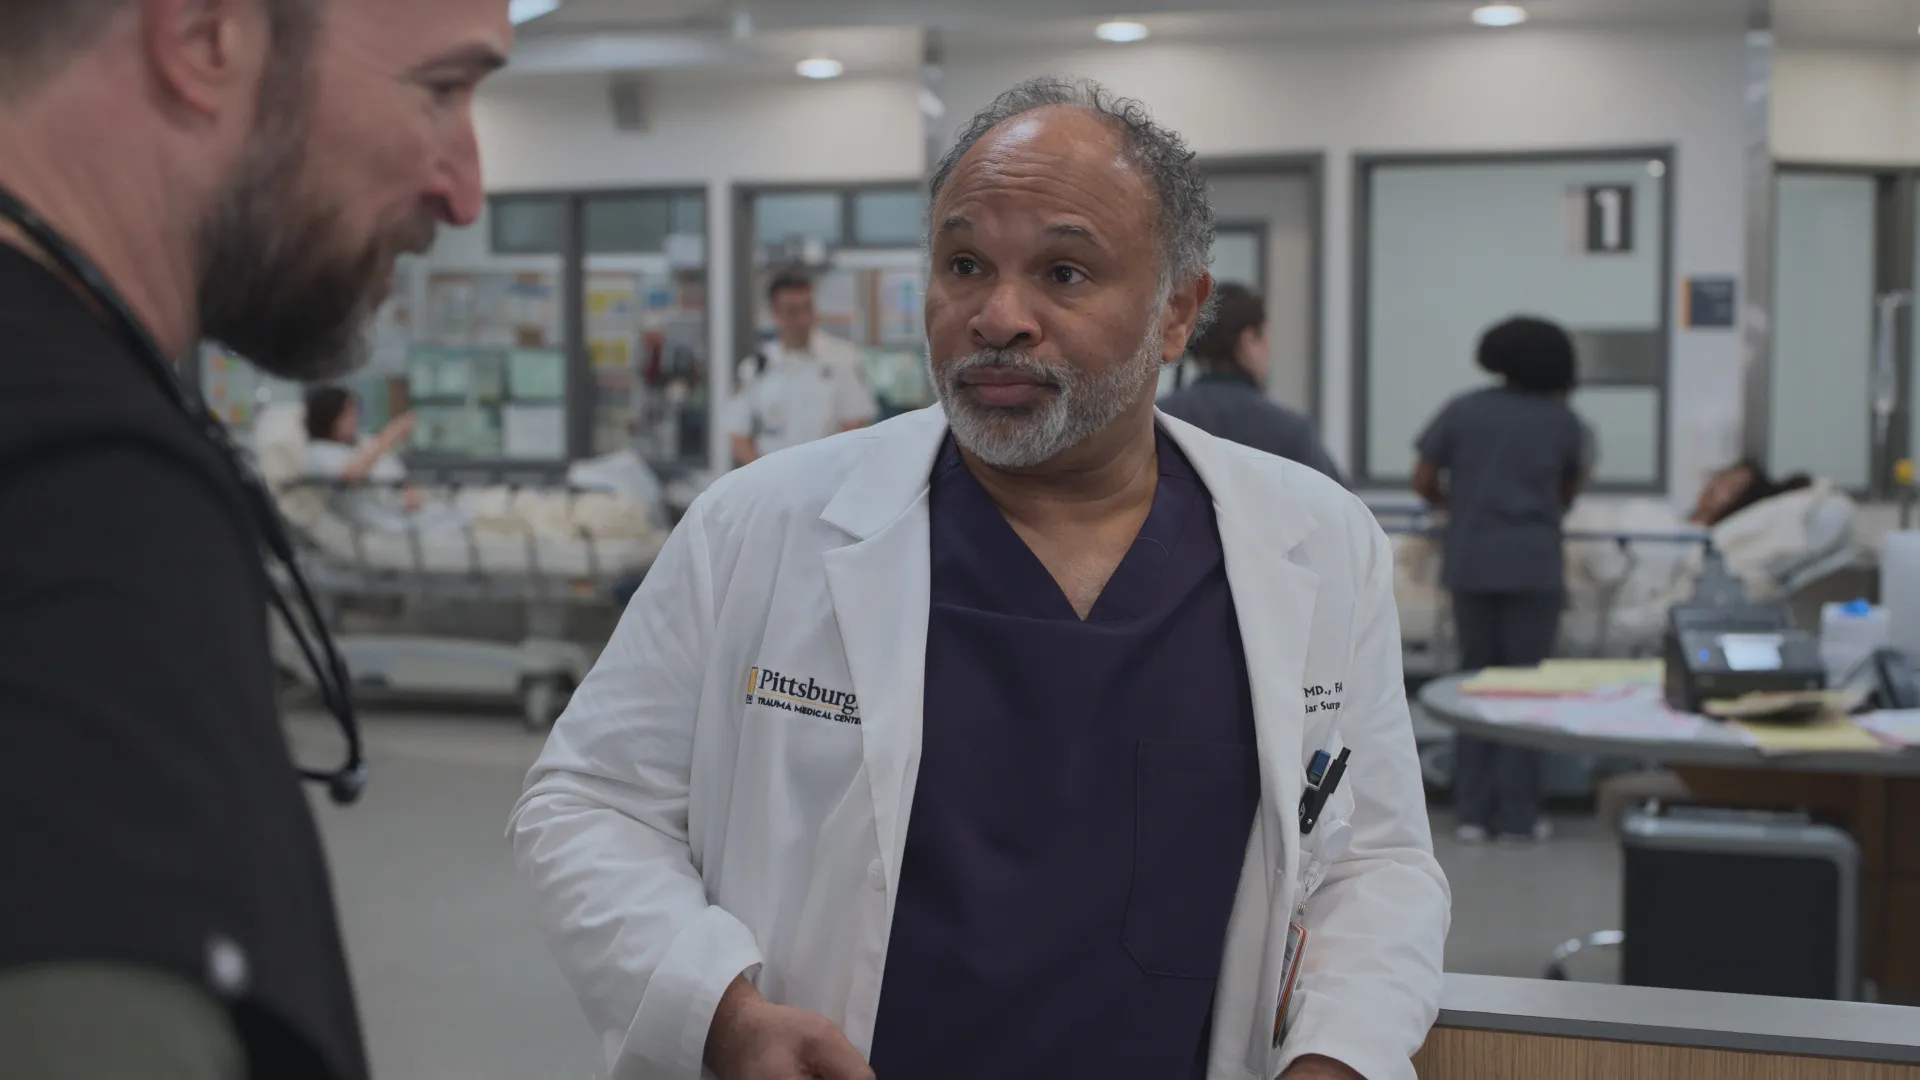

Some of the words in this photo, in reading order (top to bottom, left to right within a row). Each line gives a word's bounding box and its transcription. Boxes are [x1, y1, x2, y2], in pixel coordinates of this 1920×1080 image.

[1594, 188, 1621, 249] 1
[757, 697, 792, 712] TRAUMA
[794, 704, 832, 720] MEDICAL
[758, 668, 859, 715] Pittsburg
